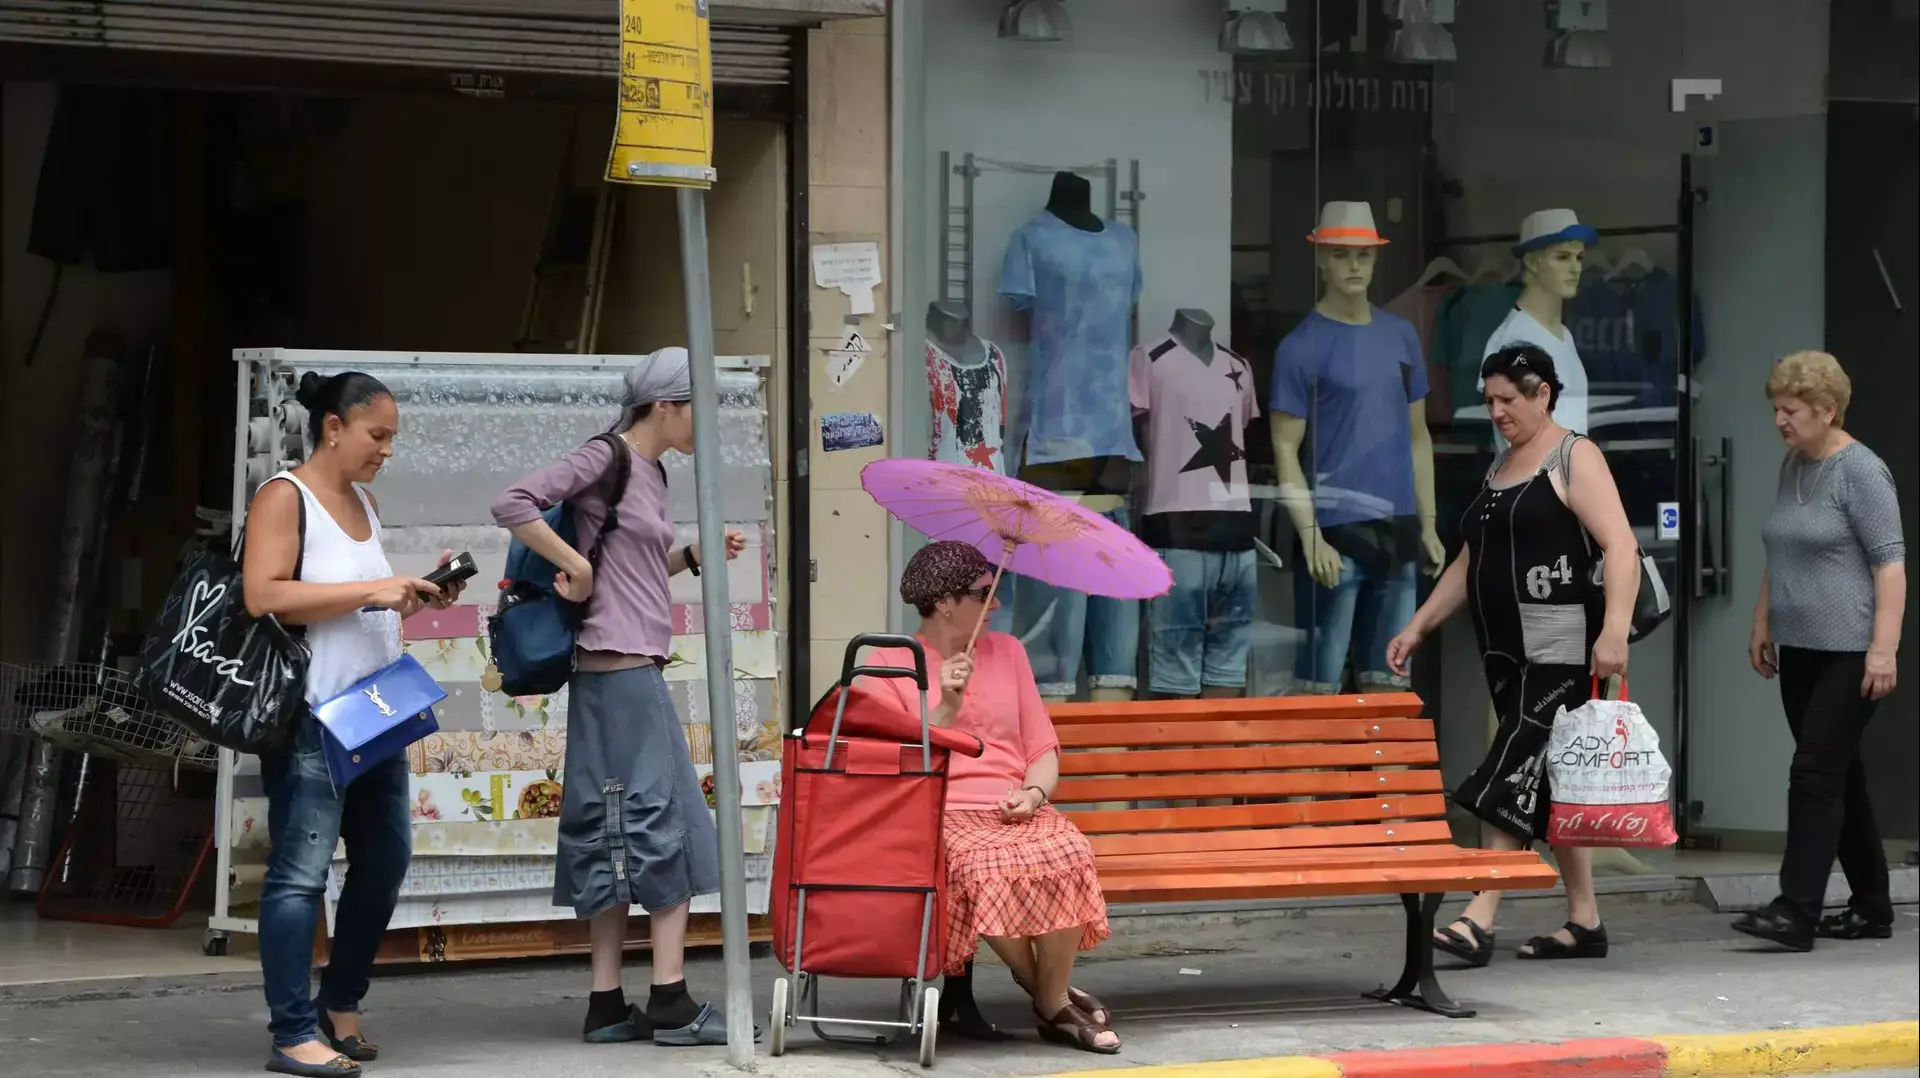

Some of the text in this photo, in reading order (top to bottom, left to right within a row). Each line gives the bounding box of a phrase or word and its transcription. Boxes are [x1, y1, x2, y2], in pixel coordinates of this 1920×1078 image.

[625, 15, 642, 35] 240
[625, 51, 636, 70] 41
[1263, 73, 1297, 116] וקו
[1526, 554, 1573, 600] 64
[1550, 751, 1655, 769] COMFORT
